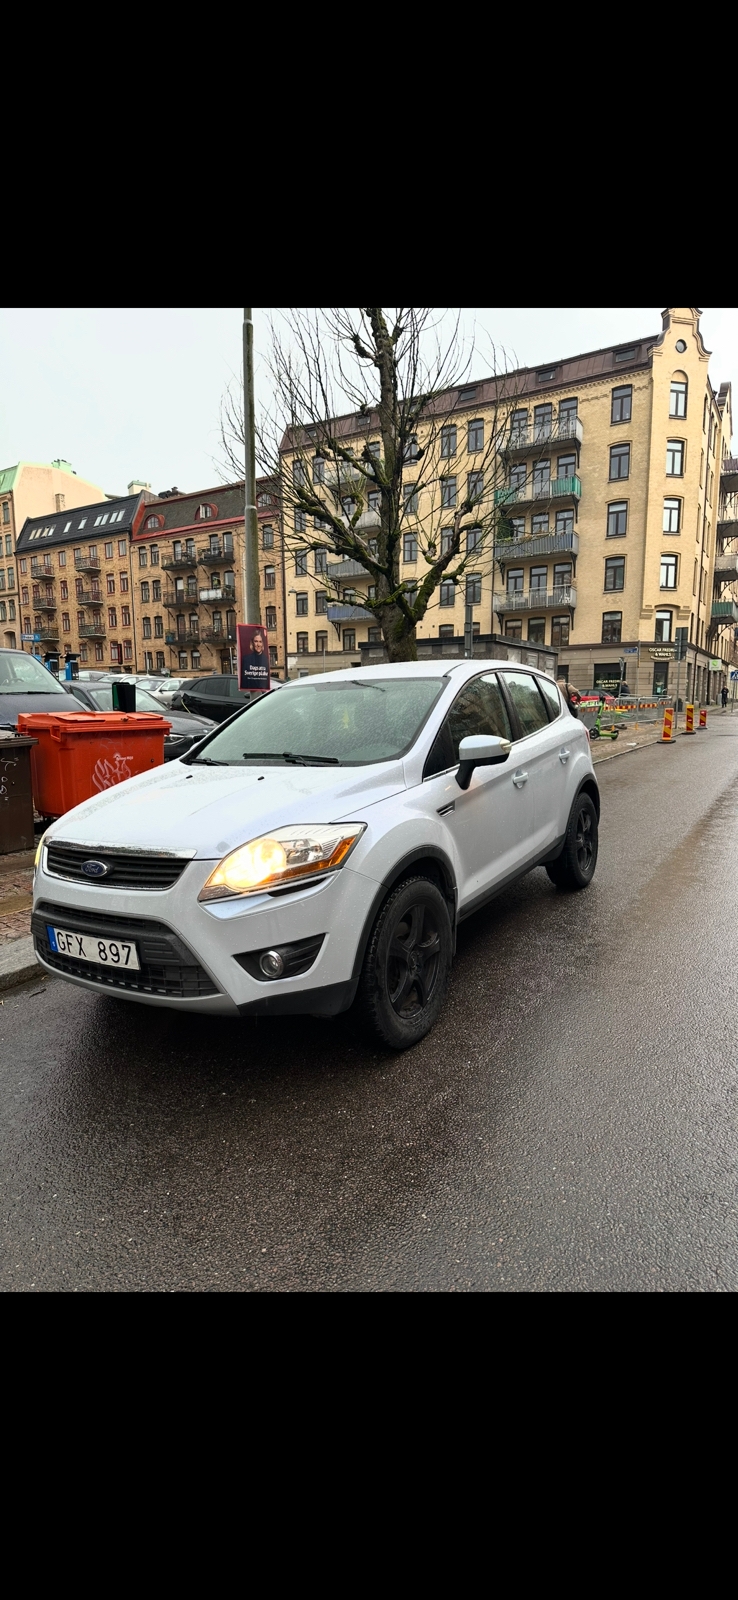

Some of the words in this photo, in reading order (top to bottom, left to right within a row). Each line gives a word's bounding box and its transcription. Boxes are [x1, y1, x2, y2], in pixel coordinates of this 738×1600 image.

[85, 863, 99, 874] Ford
[56, 931, 87, 958] GFX
[97, 941, 131, 965] 897
